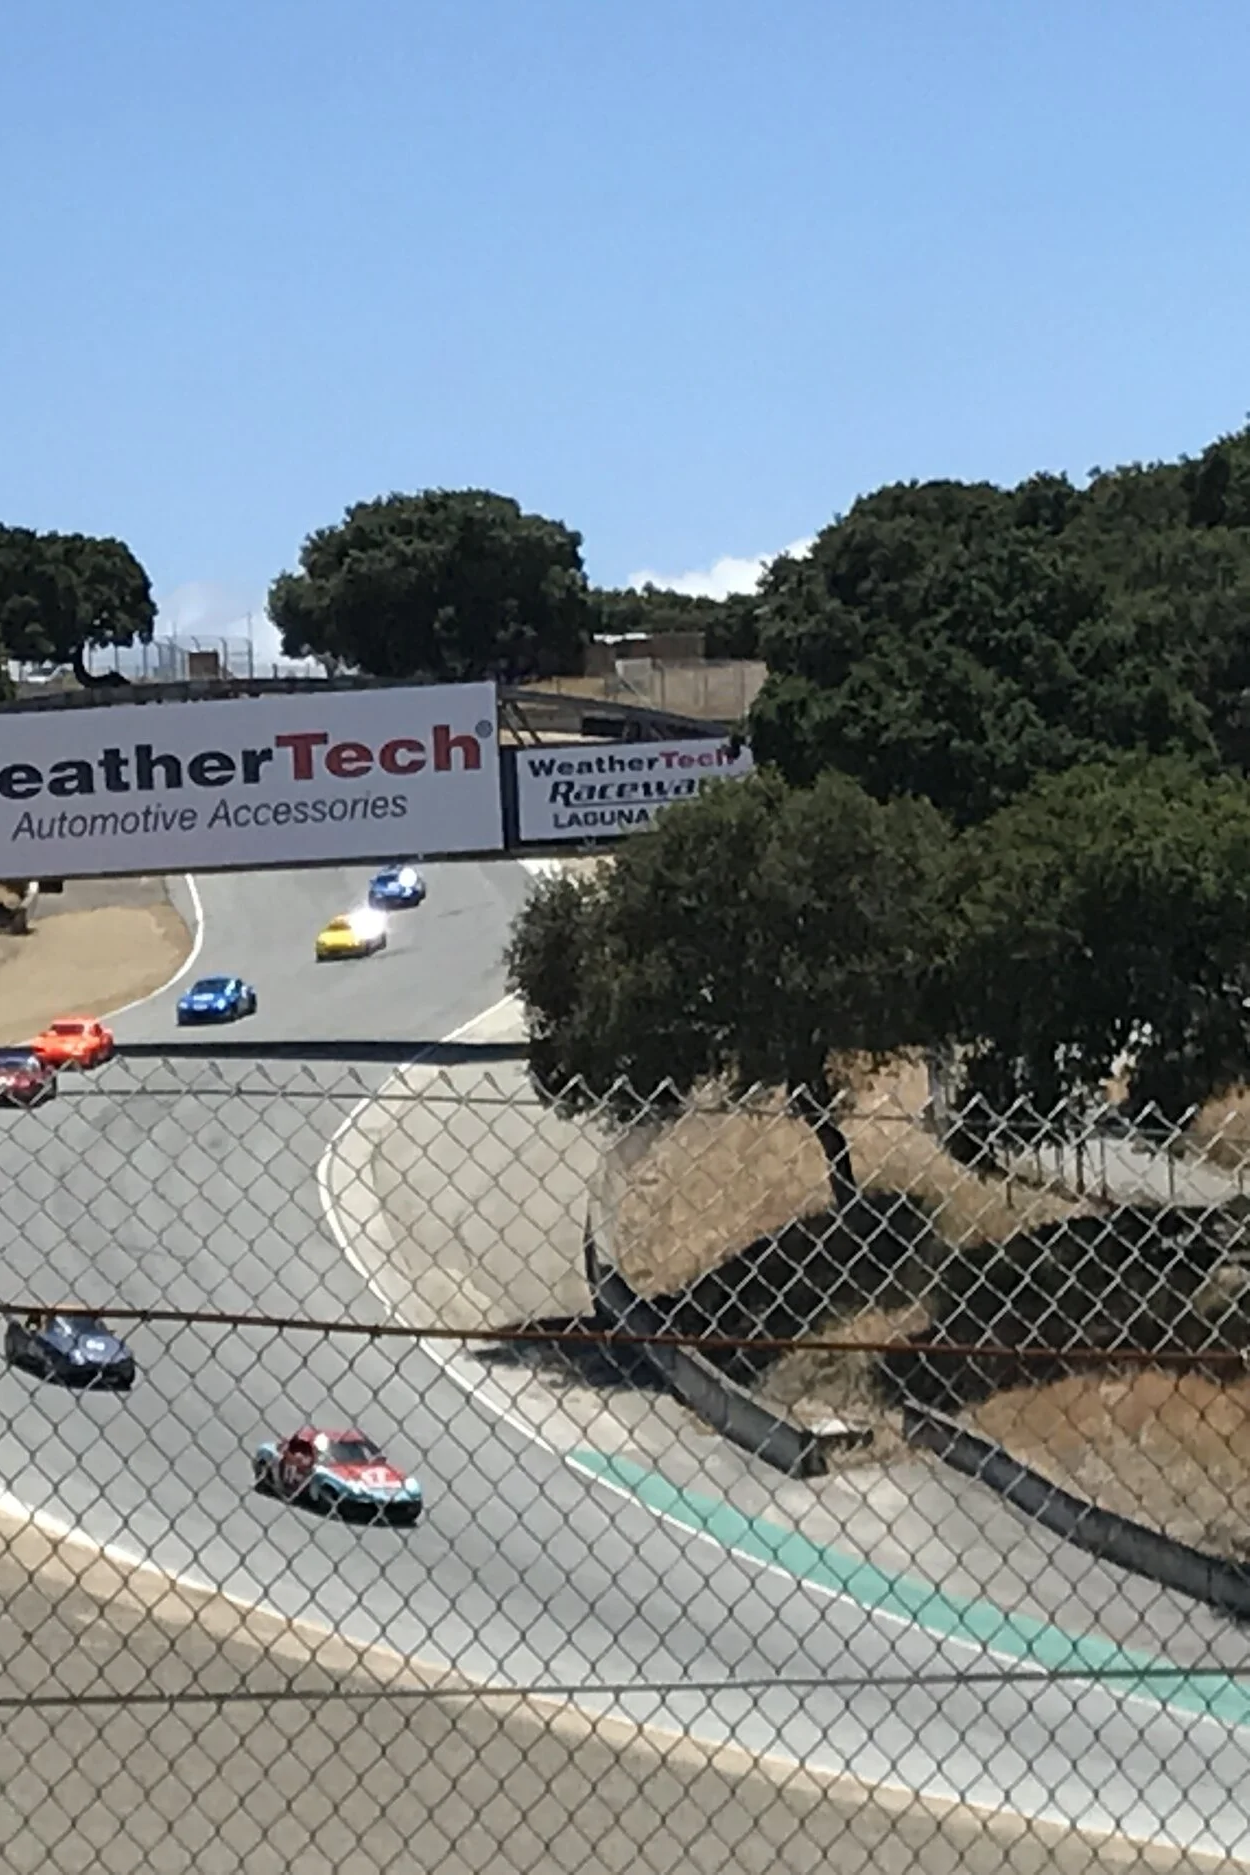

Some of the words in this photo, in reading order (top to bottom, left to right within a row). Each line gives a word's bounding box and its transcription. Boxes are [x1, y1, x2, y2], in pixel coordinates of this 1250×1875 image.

[549, 779, 696, 807] Racewa
[12, 803, 198, 842] Automotive
[208, 792, 408, 829] Accessories
[553, 809, 651, 829] LAGUNA
